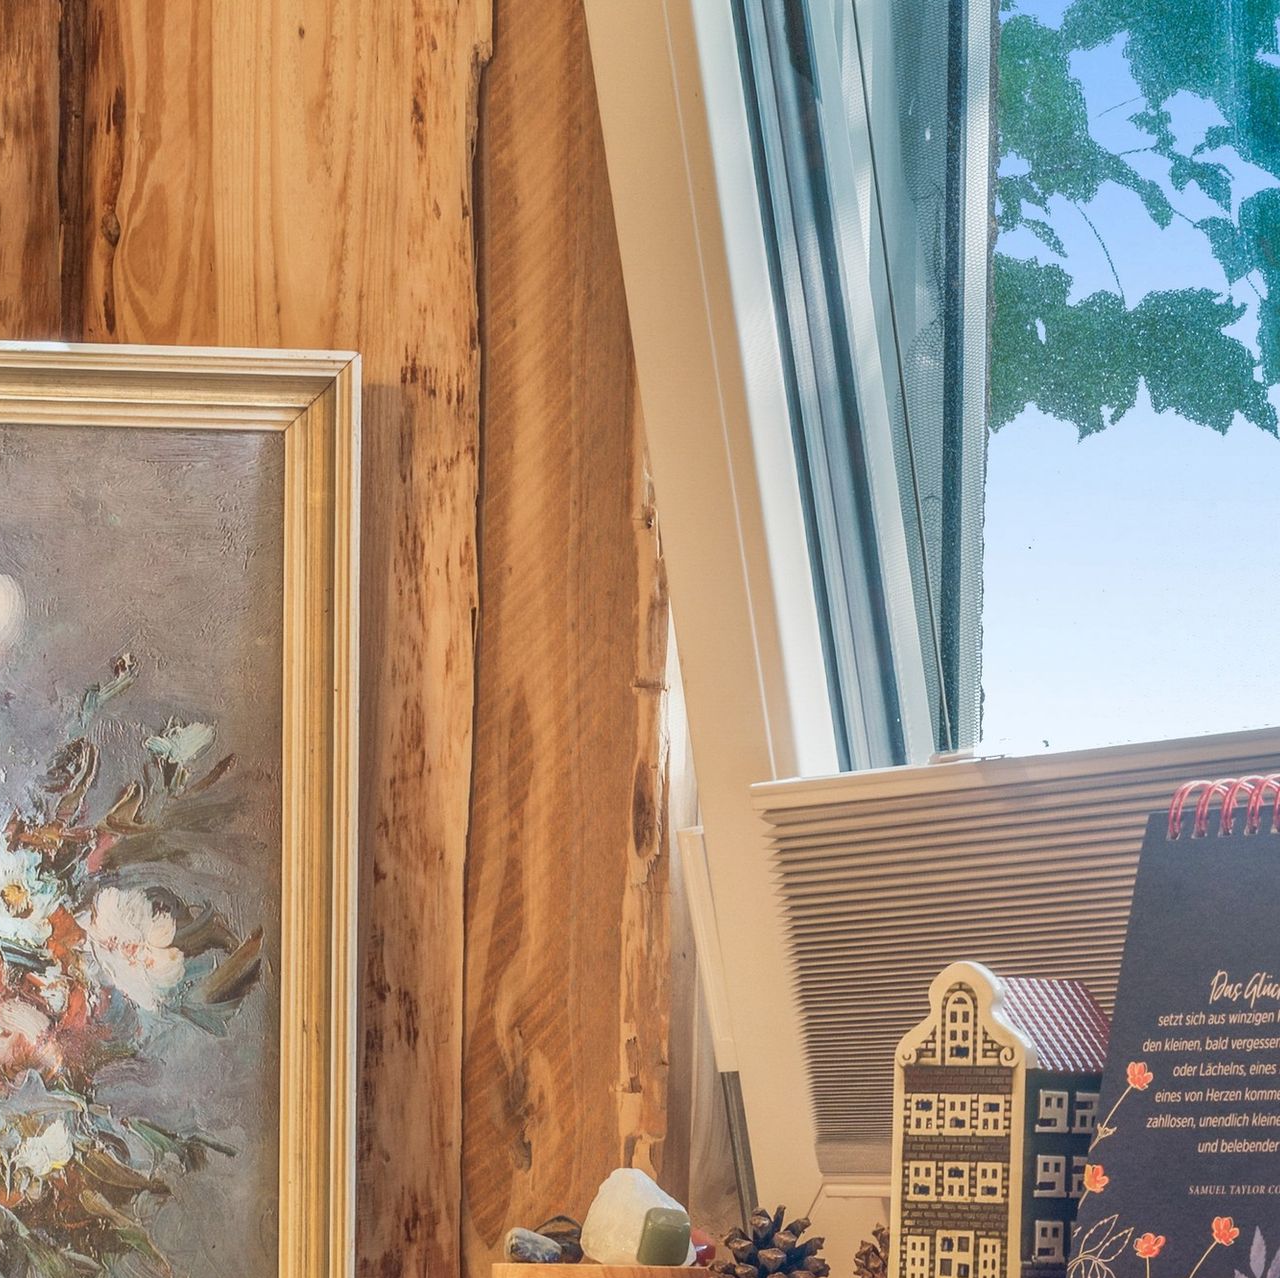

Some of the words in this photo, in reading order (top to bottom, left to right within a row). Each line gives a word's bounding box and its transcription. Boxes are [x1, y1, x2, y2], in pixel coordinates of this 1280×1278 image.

[1209, 969, 1242, 1004] Das
[1158, 1012, 1184, 1027] setzt
[1185, 1011, 1206, 1026] sich
[1207, 1013, 1226, 1025] aus
[1228, 1010, 1275, 1026] winzigen
[1142, 1038, 1163, 1053] den
[1163, 1037, 1203, 1053] kleinen,
[1205, 1036, 1229, 1051] bald
[1173, 1062, 1198, 1077] oder
[1199, 1061, 1247, 1077] Lächelns,
[1249, 1062, 1277, 1076] eines
[1155, 1089, 1182, 1103] eines
[1184, 1091, 1204, 1102] von
[1205, 1088, 1242, 1102] Herzen
[1146, 1113, 1196, 1129] zahllosen,
[1199, 1112, 1249, 1127] unendlich
[1198, 1139, 1218, 1153] und
[1220, 1138, 1279, 1153] belebender
[1188, 1185, 1227, 1195] SAMUEL
[1229, 1184, 1266, 1195] TAYLOR
